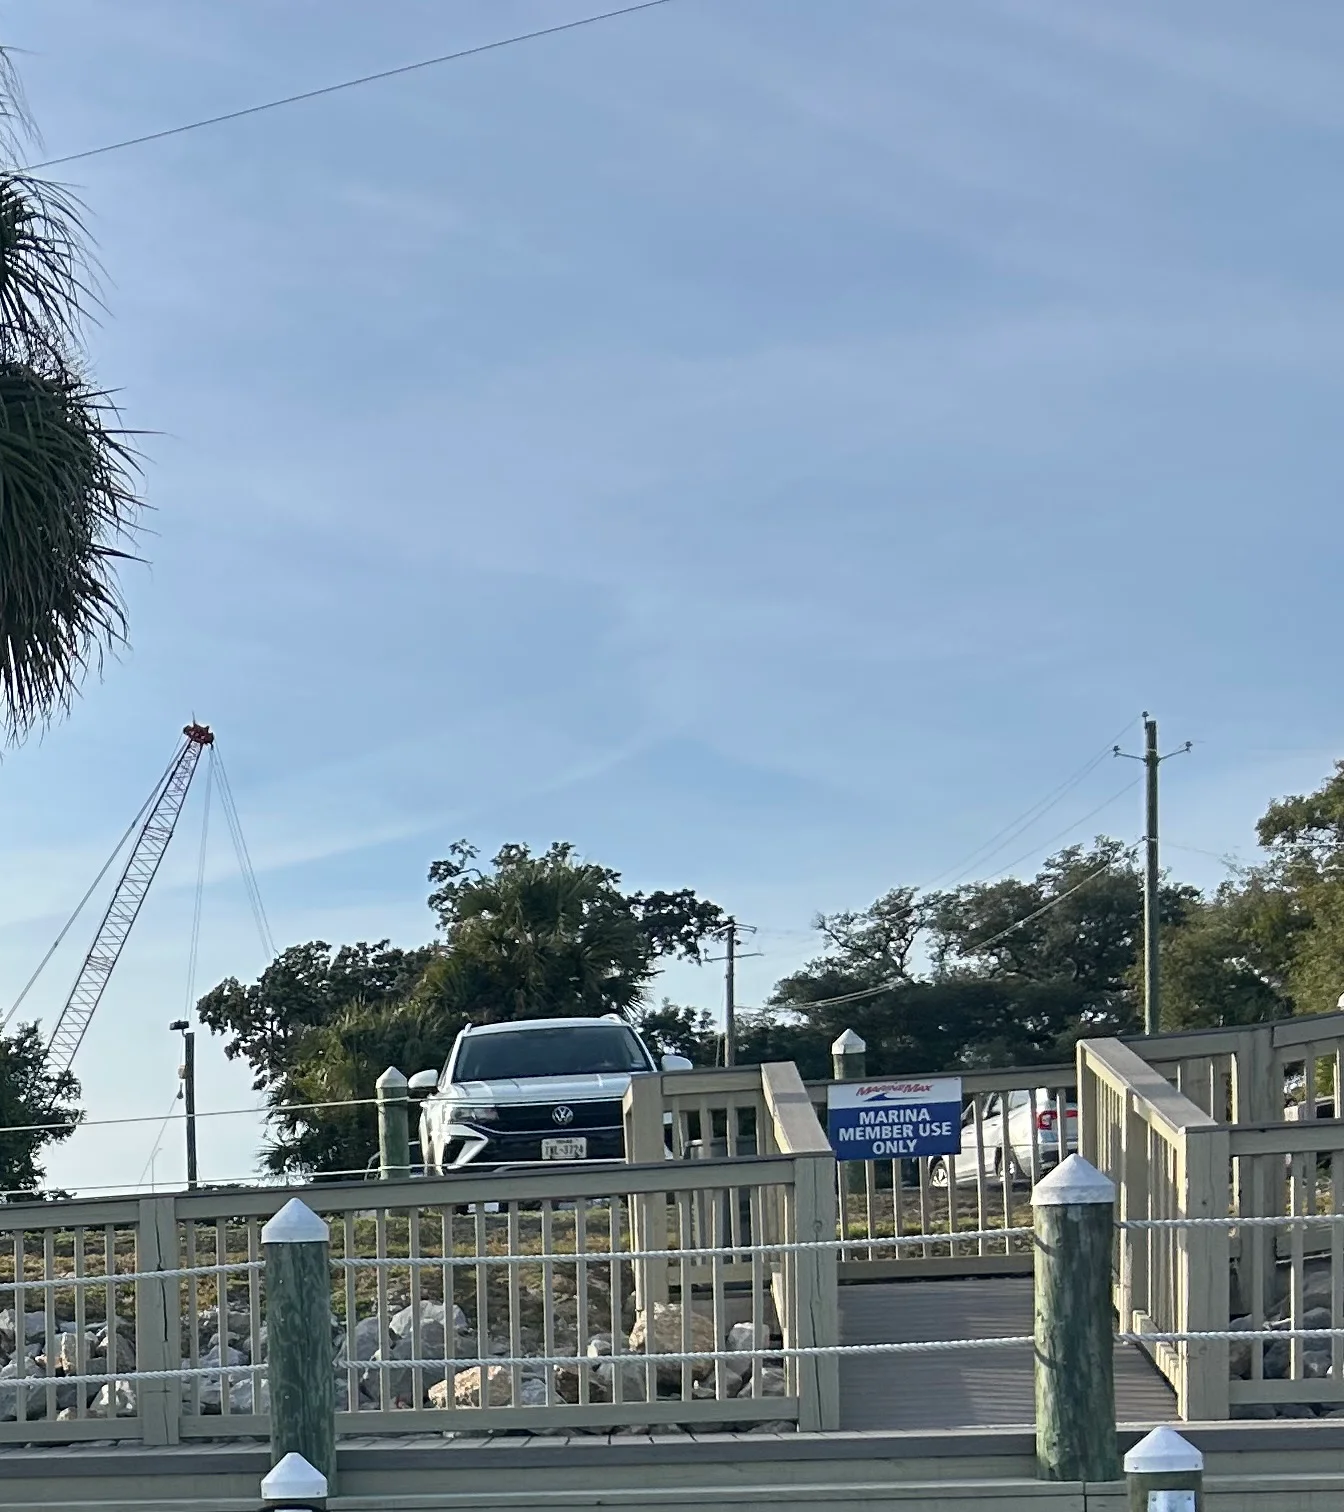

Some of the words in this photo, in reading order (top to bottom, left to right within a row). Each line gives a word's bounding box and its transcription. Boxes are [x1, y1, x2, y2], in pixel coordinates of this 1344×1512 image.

[859, 1108, 931, 1125] MARINA
[838, 1124, 914, 1141] MEMBER
[918, 1122, 952, 1137] USE
[872, 1139, 918, 1155] ONLY
